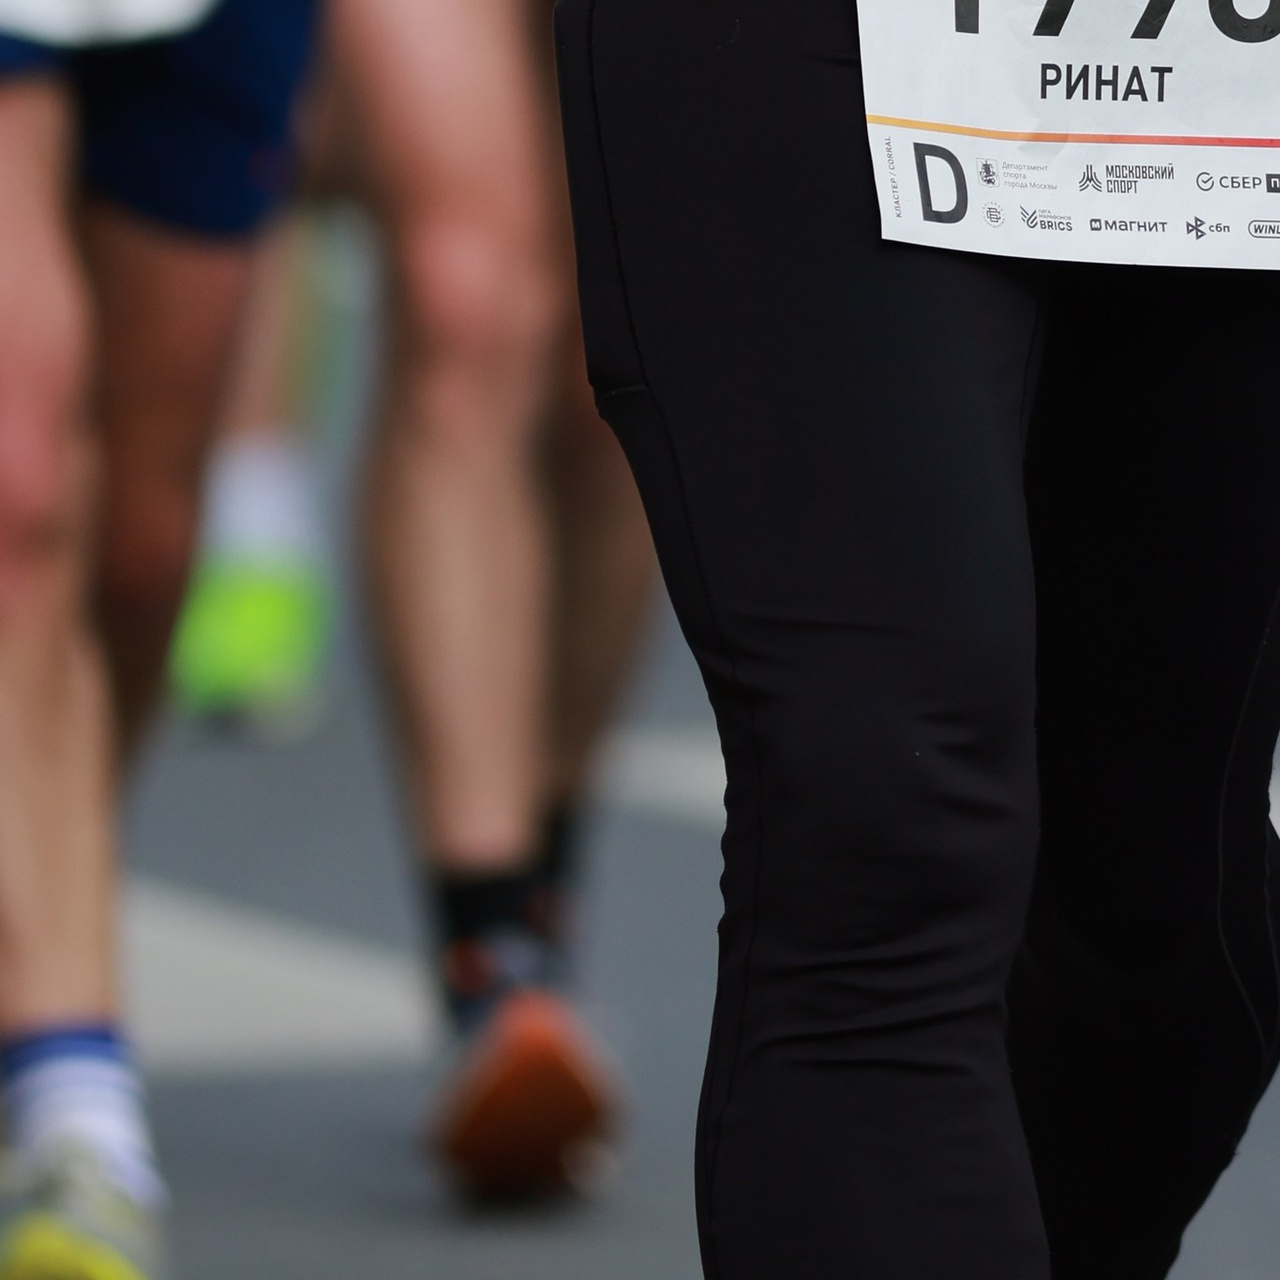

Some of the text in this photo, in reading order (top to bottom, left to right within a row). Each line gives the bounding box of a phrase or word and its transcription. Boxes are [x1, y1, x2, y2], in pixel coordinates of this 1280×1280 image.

[1039, 63, 1174, 103] РИНАТ
[885, 136, 895, 170] CORRAL
[1002, 161, 1048, 172] Департамент
[1106, 163, 1174, 179] МОСКОВСКИЙ
[1003, 172, 1027, 180] спорта
[1219, 176, 1262, 189] СБЕР
[912, 142, 968, 224] D
[1004, 181, 1058, 190] города Москвы
[1106, 180, 1138, 194] СПОРТ
[890, 178, 902, 218] КЛАСТЕР
[1039, 220, 1073, 231] BRICS
[1104, 220, 1168, 232] магнит
[1208, 223, 1230, 233] сбп
